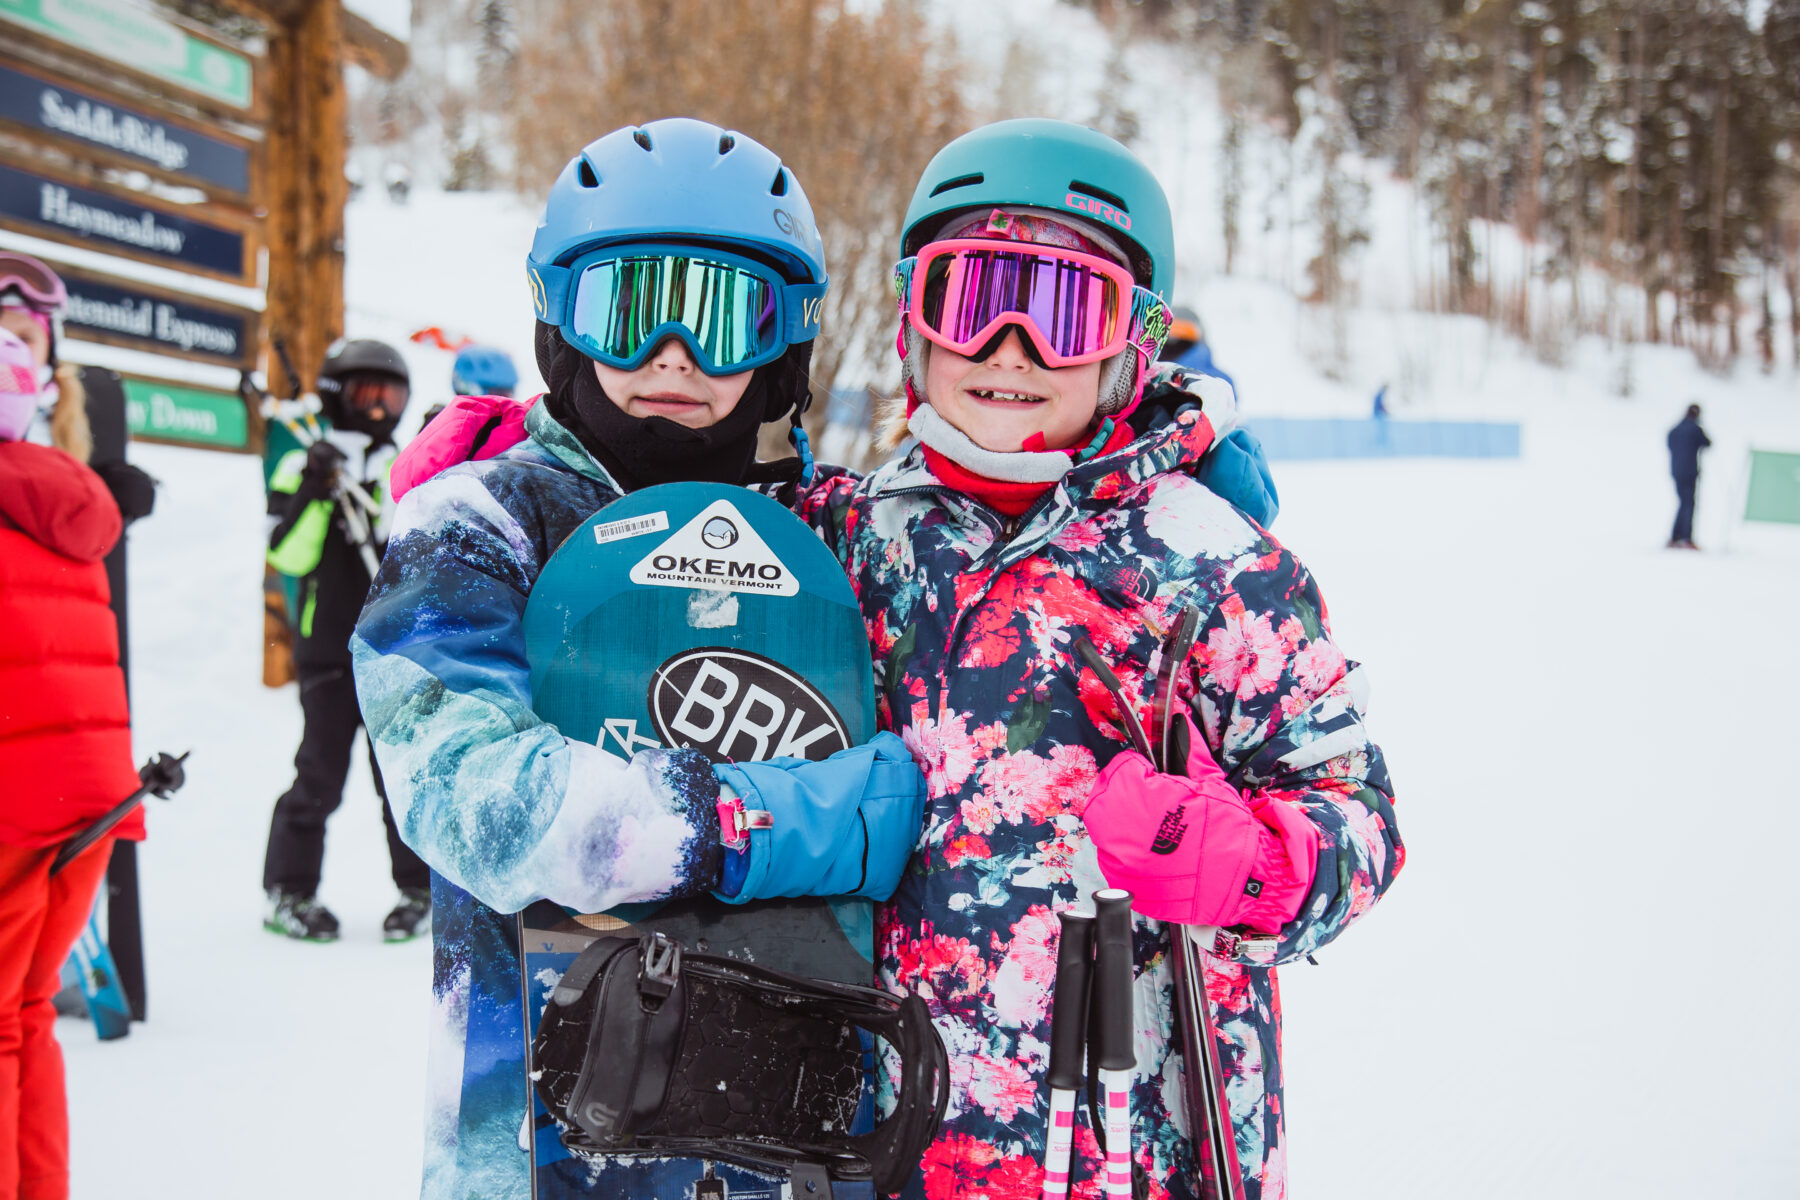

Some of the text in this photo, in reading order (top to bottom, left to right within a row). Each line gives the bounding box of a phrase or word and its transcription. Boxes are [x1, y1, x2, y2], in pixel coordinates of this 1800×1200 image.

[40, 183, 186, 254] Haymeadow
[1065, 193, 1132, 230] GIRO
[155, 303, 237, 354] Express
[150, 392, 218, 436] Down
[646, 572, 783, 590] MOUNTAIN VERMONT
[652, 555, 782, 580] OKEMO
[670, 657, 837, 762] BRK
[1157, 810, 1176, 838] FACE
[1165, 804, 1186, 841] NORTH
[1174, 823, 1188, 844] THE
